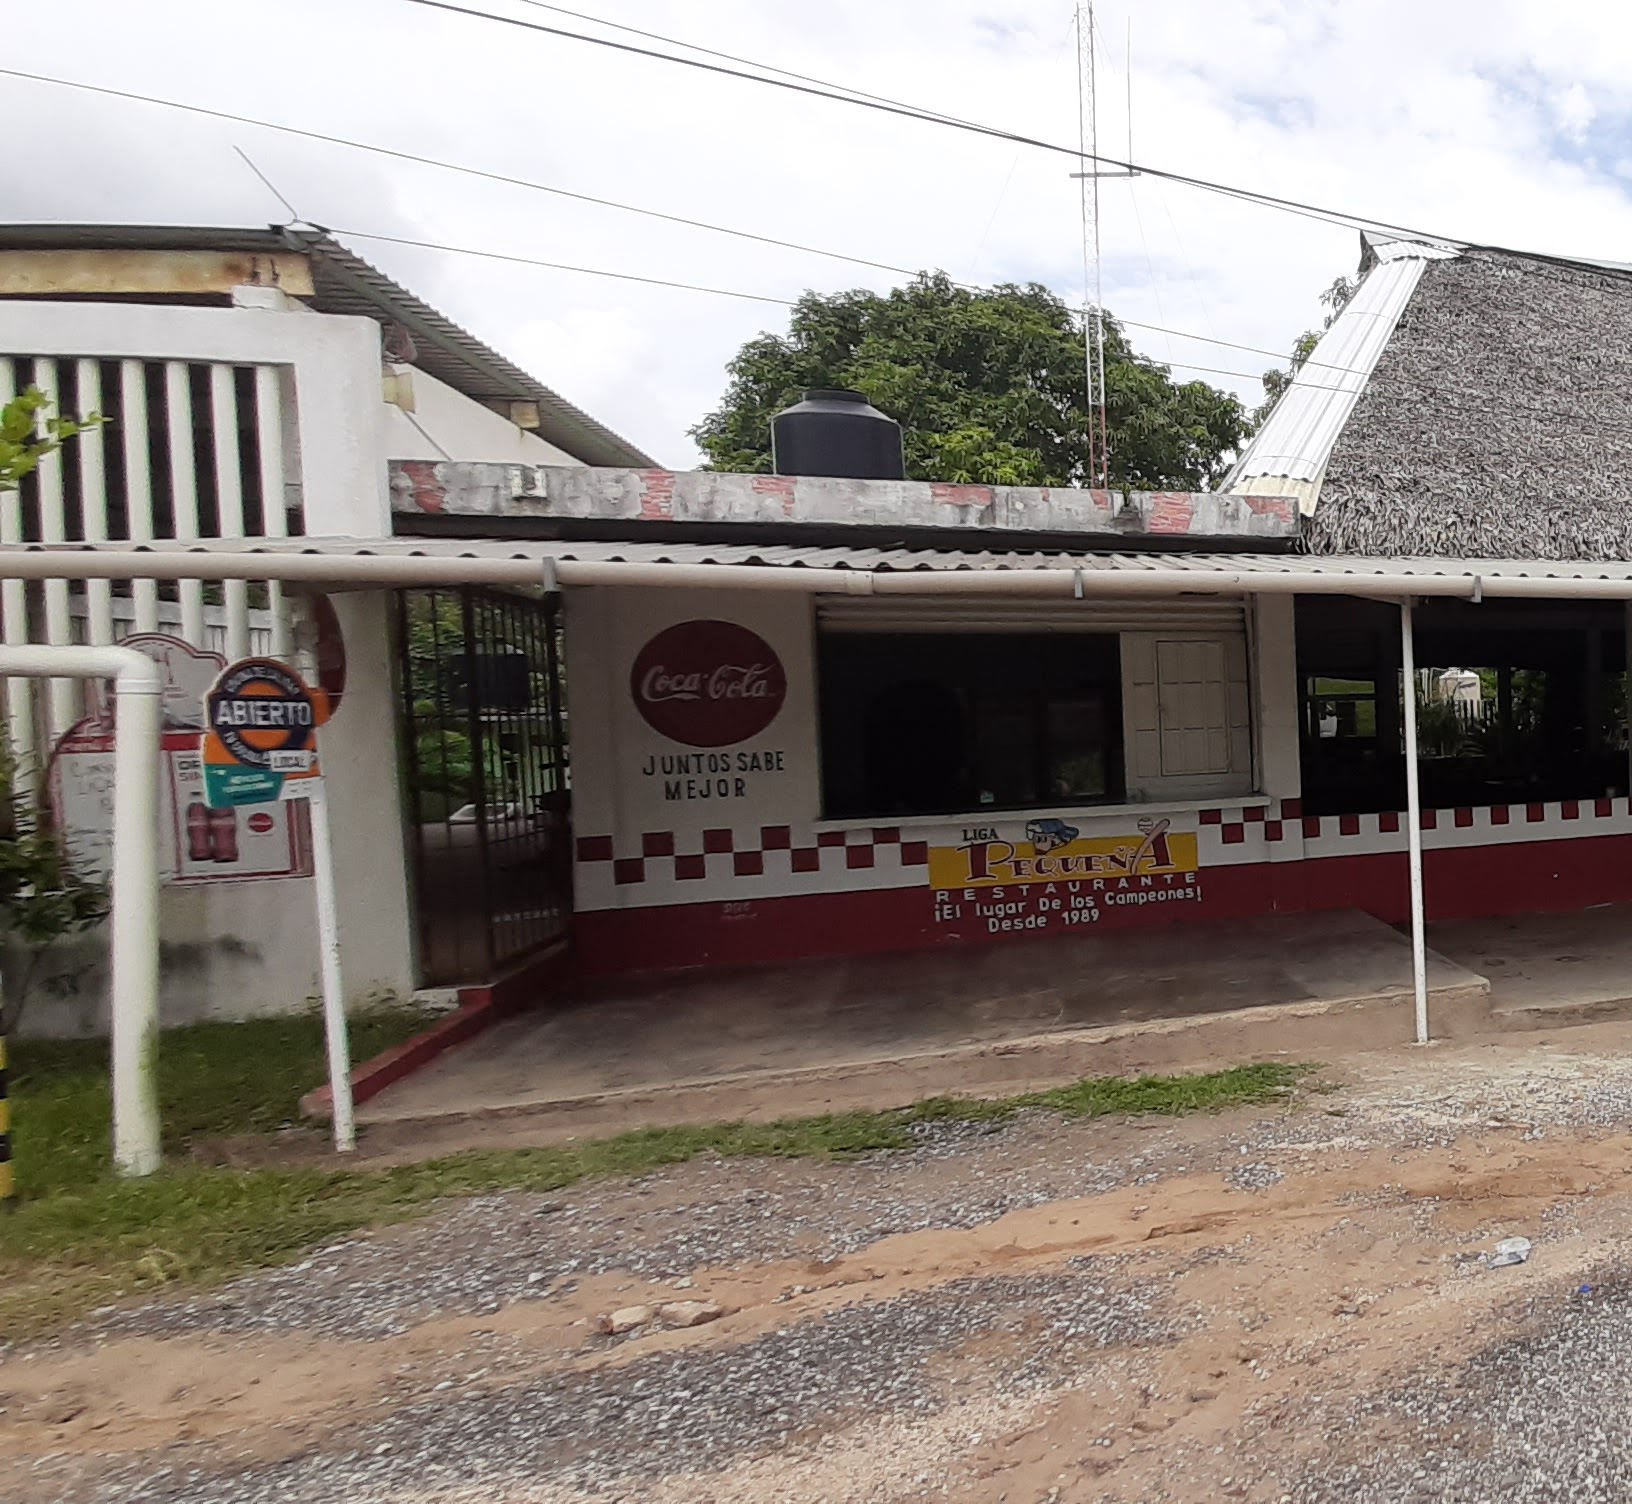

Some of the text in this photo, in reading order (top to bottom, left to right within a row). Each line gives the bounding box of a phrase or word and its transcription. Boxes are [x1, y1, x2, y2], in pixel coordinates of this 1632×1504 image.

[641, 663, 777, 702] Coca-Cola
[215, 700, 313, 726] ABIERTO
[643, 750, 785, 776] JUNTOS SABE
[664, 777, 747, 801] MEJOR
[961, 827, 999, 841] LIGA
[935, 871, 1197, 903] RESTAURANTE
[975, 901, 1027, 918] lugar
[1039, 897, 1062, 912] De
[1070, 894, 1096, 909] los
[1104, 884, 1203, 906] Campeones!
[987, 907, 1101, 934] Desde 1989
